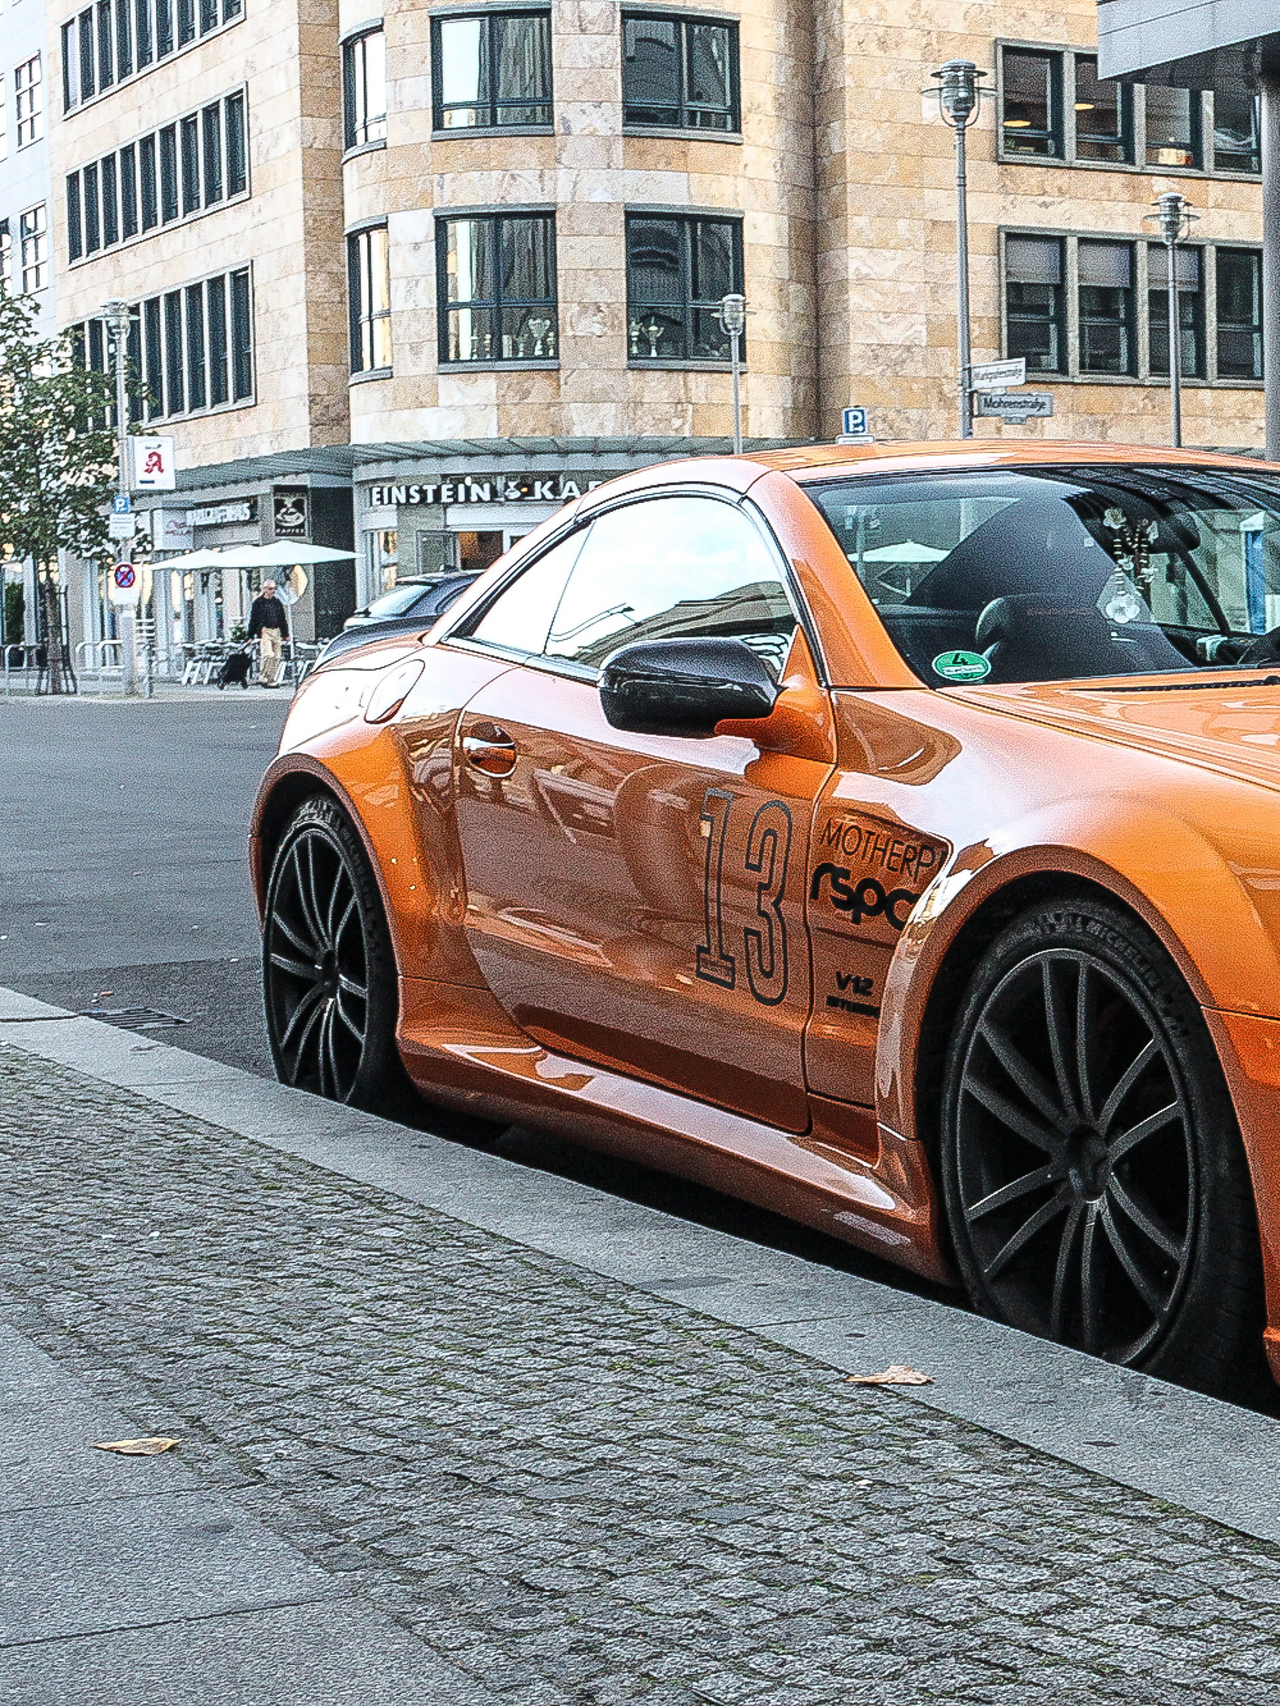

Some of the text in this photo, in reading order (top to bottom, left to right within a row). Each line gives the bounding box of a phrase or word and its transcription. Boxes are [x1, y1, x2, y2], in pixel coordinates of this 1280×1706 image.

[115, 498, 126, 512] P
[372, 482, 491, 506] EINSTEIN
[952, 653, 968, 665] 4
[696, 787, 792, 1006] 13
[1086, 919, 1162, 988] MICHELIN
[836, 971, 873, 996] V12
